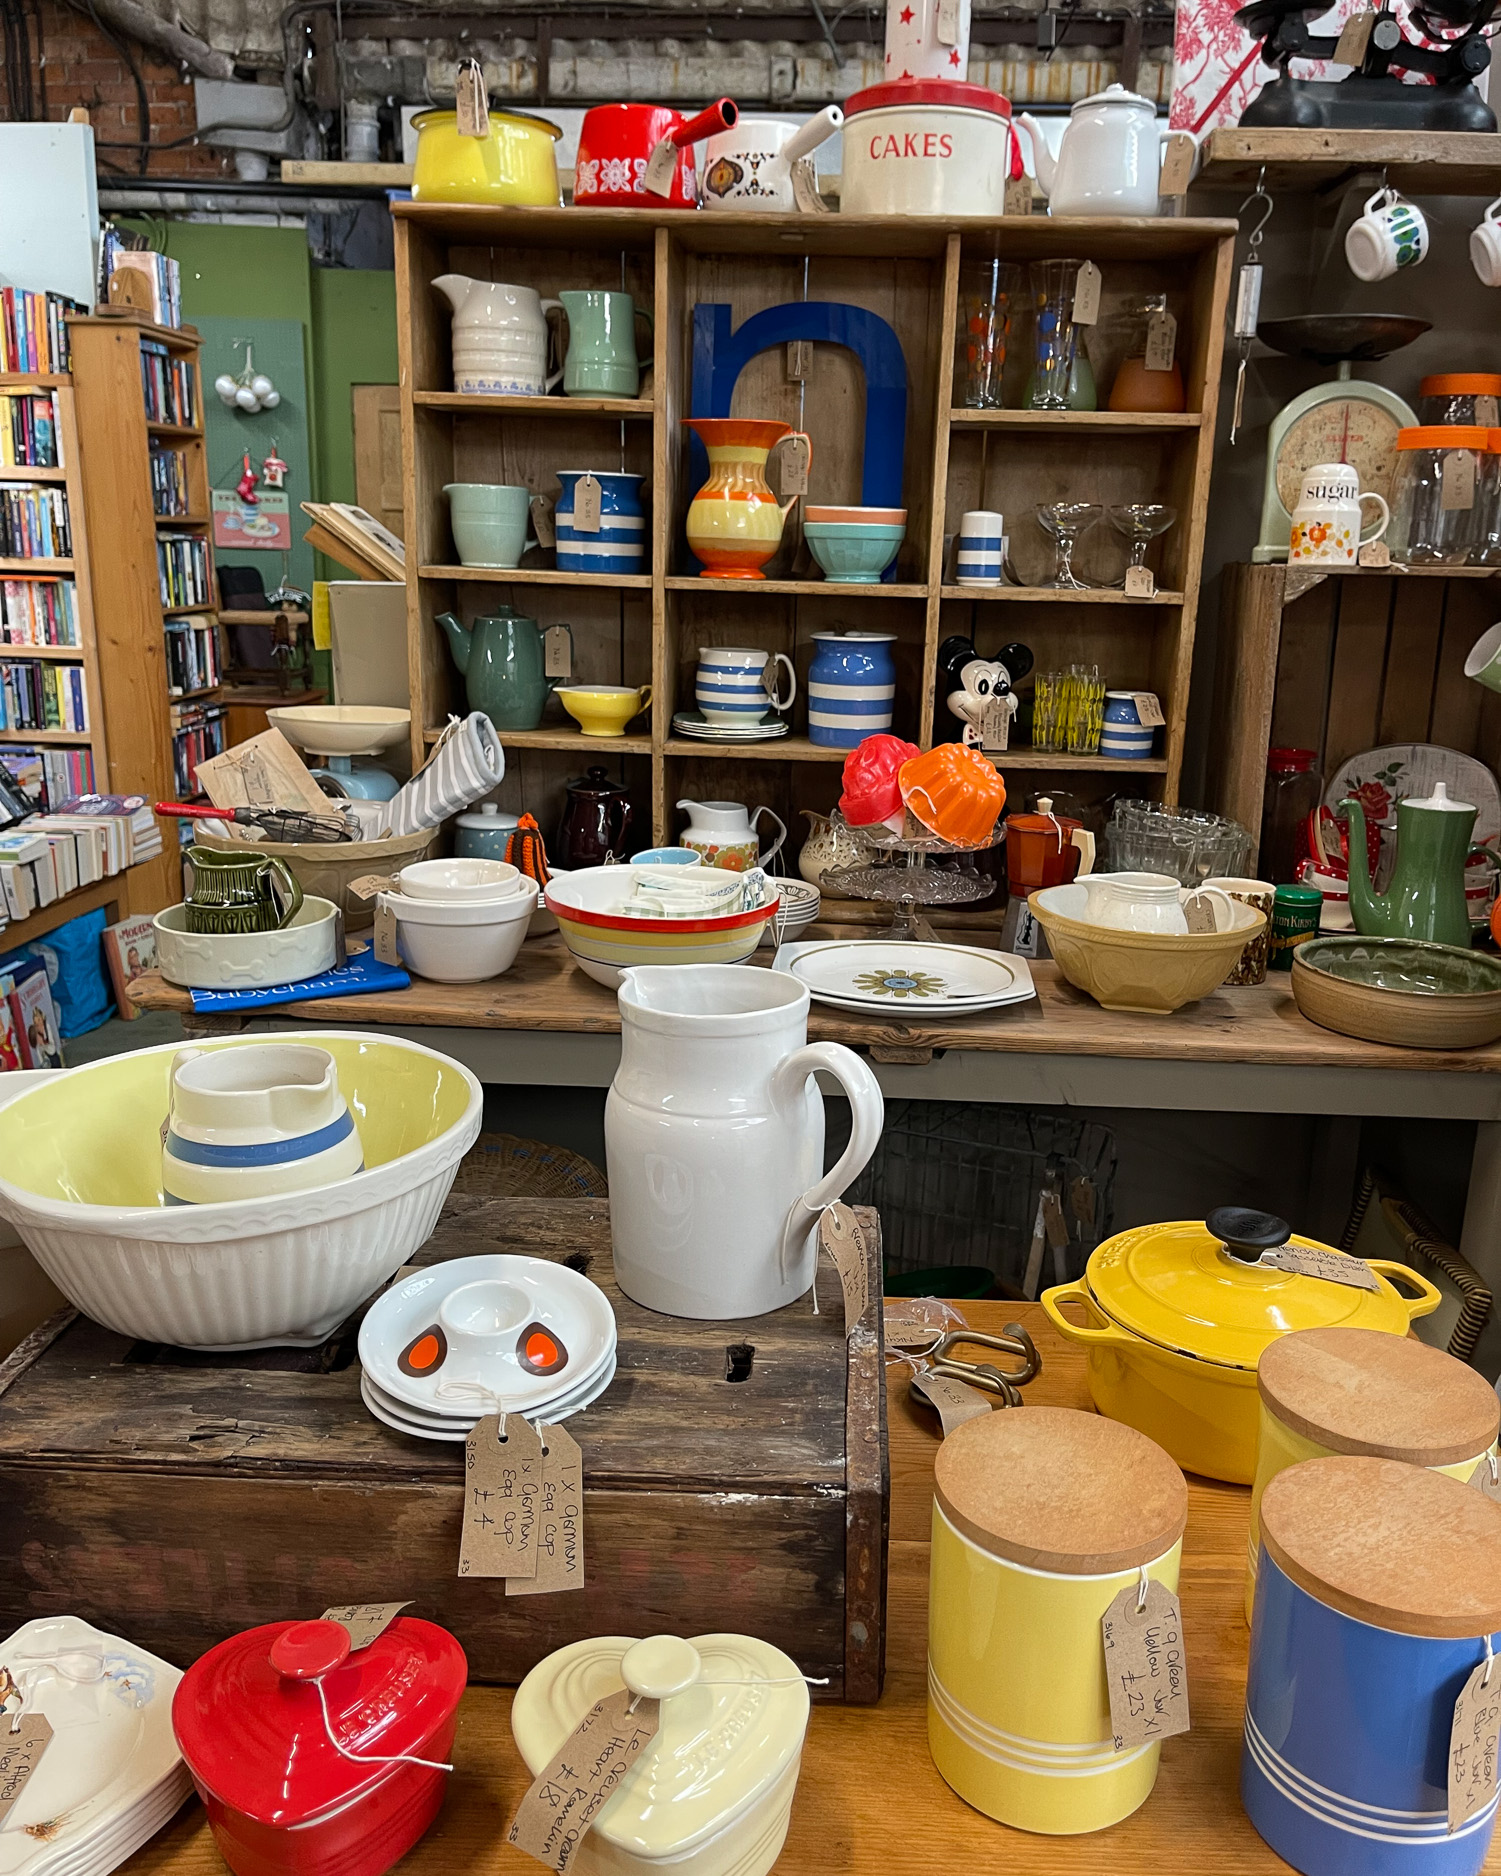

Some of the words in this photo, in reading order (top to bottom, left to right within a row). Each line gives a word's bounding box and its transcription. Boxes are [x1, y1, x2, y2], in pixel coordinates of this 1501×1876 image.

[870, 133, 953, 160] CAKES
[1306, 484, 1357, 504] sugar
[1316, 1264, 1350, 1279] £35
[466, 1440, 477, 1470] 3150
[461, 1558, 470, 1574] 33
[1104, 1622, 1115, 1650] 3169
[1121, 1670, 1147, 1717] £23
[575, 1702, 604, 1735] 3172
[25, 1738, 45, 1748] 6
[624, 1728, 651, 1757] Le
[1113, 1735, 1123, 1749] 33
[589, 1736, 626, 1783] Heart
[1452, 1743, 1471, 1784] £23
[538, 1763, 580, 1808] £18
